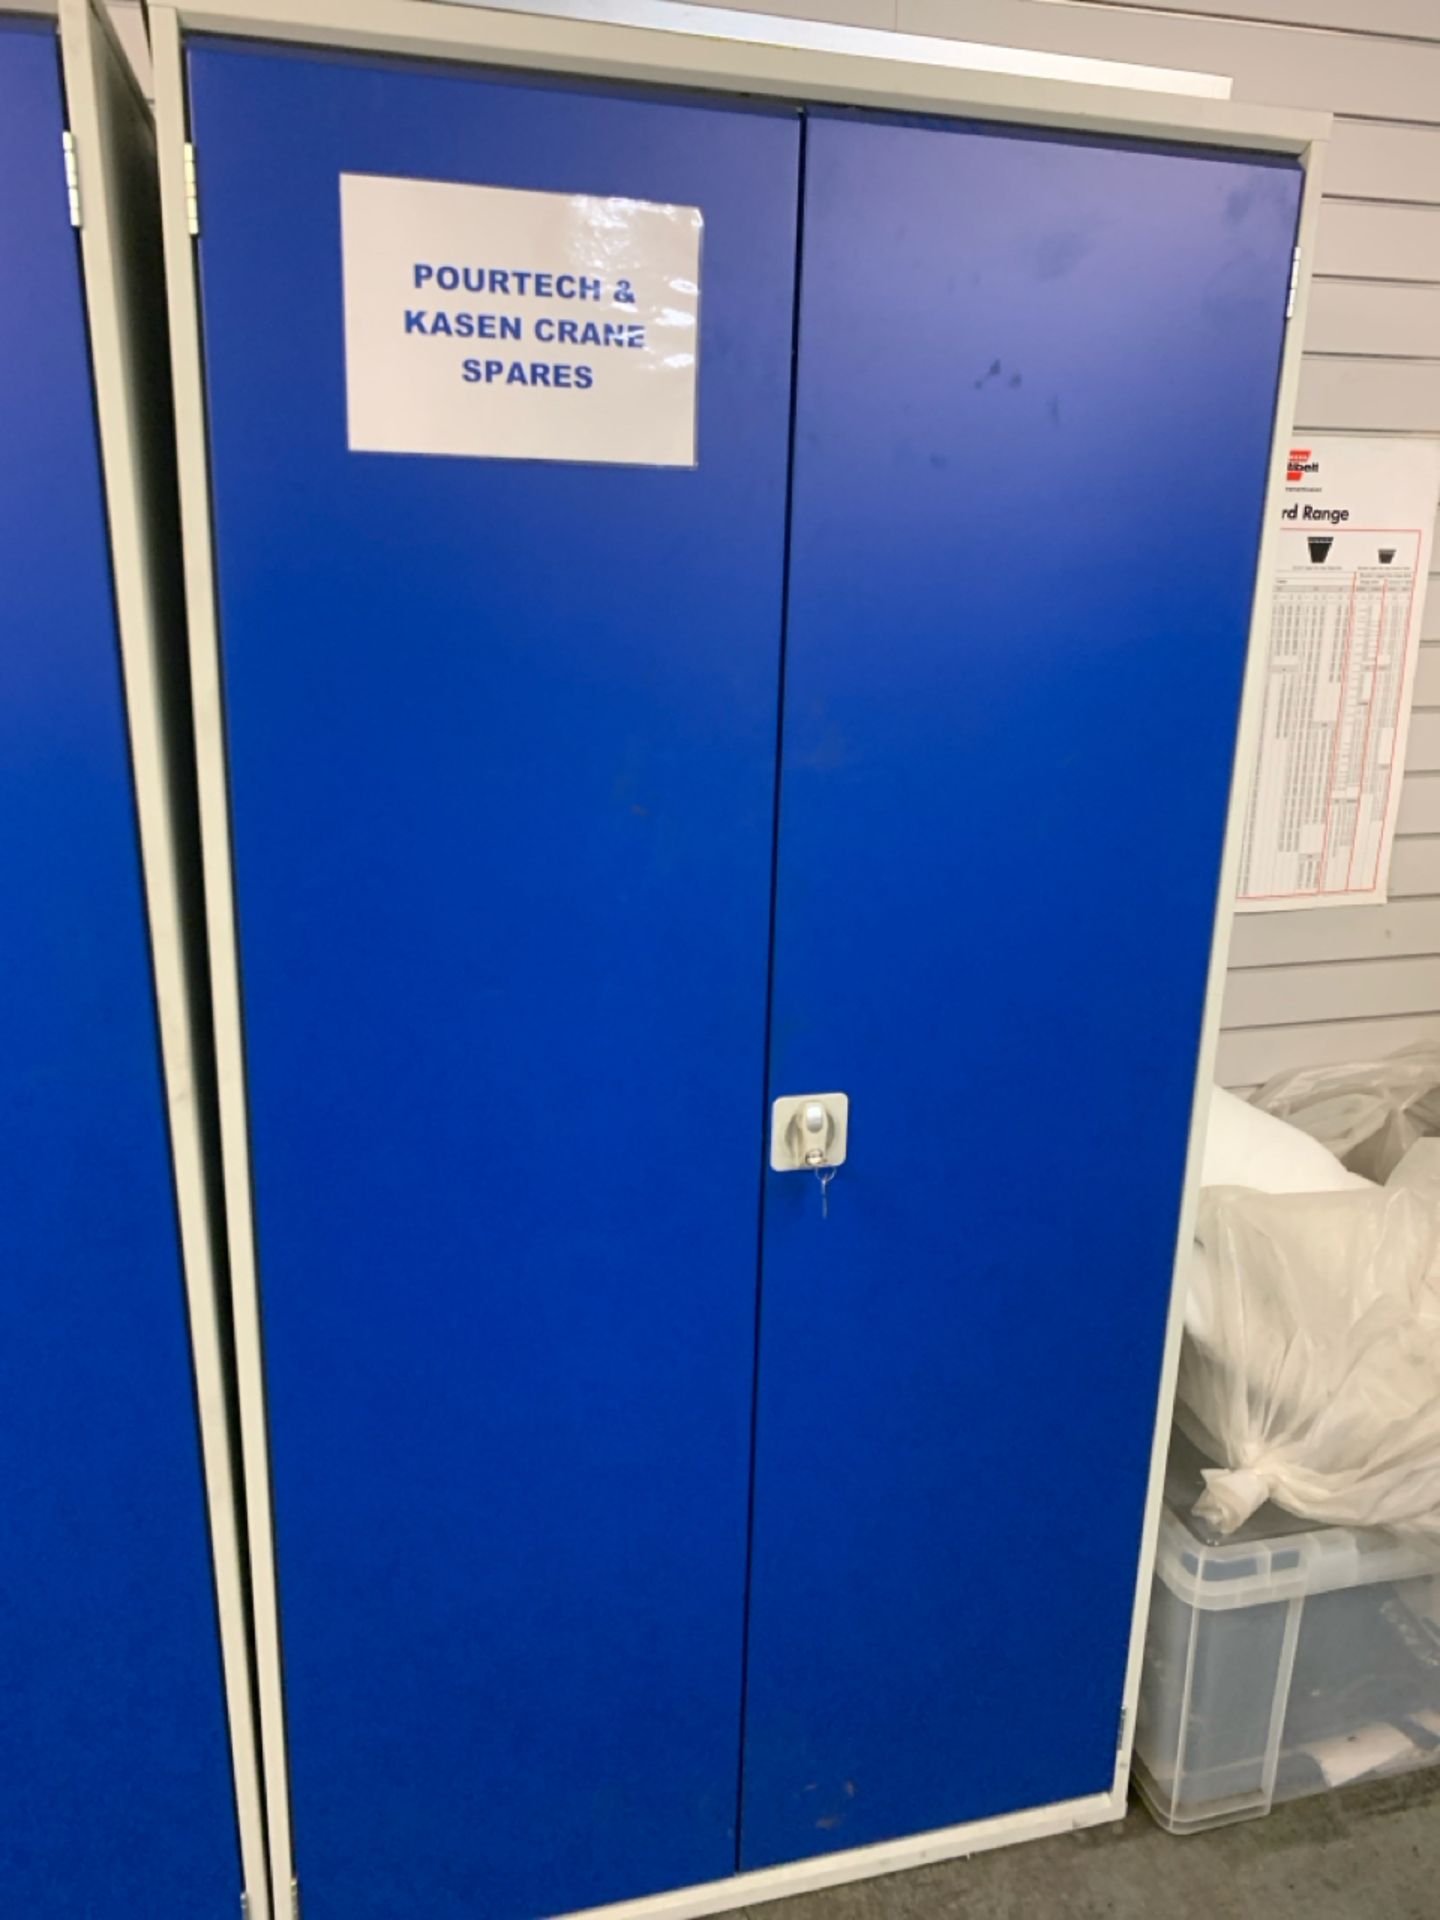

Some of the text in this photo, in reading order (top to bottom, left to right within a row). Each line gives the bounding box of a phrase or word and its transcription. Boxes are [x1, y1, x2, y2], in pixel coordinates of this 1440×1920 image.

[414, 264, 635, 303] POURTECH &
[404, 310, 645, 348] KASEN CRANE
[462, 359, 594, 389] SPARES
[1302, 504, 1349, 524] Range
